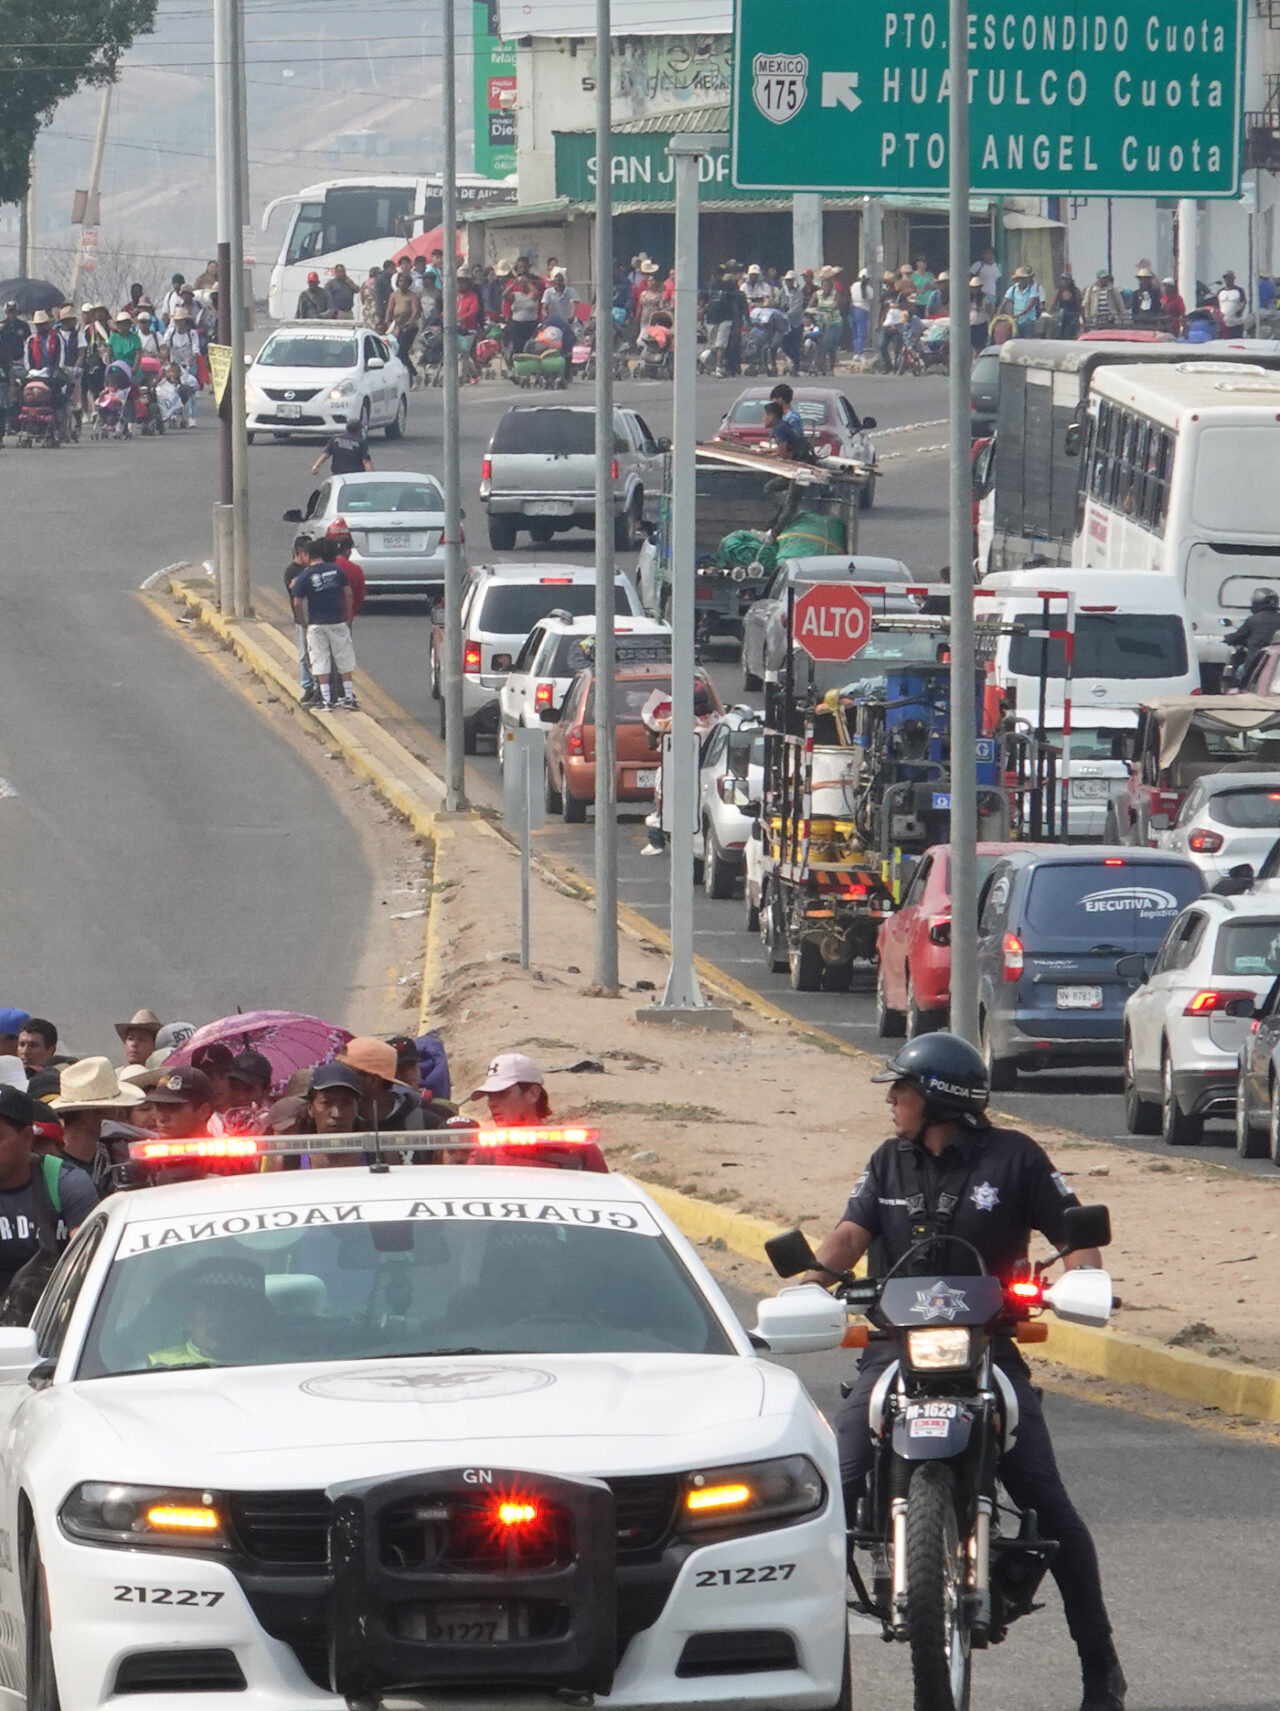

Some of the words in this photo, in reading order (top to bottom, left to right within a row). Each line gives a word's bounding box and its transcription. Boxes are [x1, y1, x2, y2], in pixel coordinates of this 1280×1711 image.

[966, 15, 1128, 52] ESCONDIDO
[1146, 16, 1224, 52] Cuota
[758, 61, 804, 74] MEXICO
[763, 80, 798, 110] 175
[883, 68, 1087, 106] HUATULCO
[1114, 70, 1222, 107] Cuota
[982, 134, 1098, 171] ANGEL
[1122, 135, 1220, 172] Cuota
[801, 607, 863, 638] ALTO
[1085, 899, 1152, 912] EJECUTIVA
[930, 1078, 969, 1098] POLICIA
[905, 1403, 957, 1420] M-1623
[463, 1470, 493, 1484] GN
[695, 1563, 796, 1588] 21227
[114, 1585, 225, 1607] 21227
